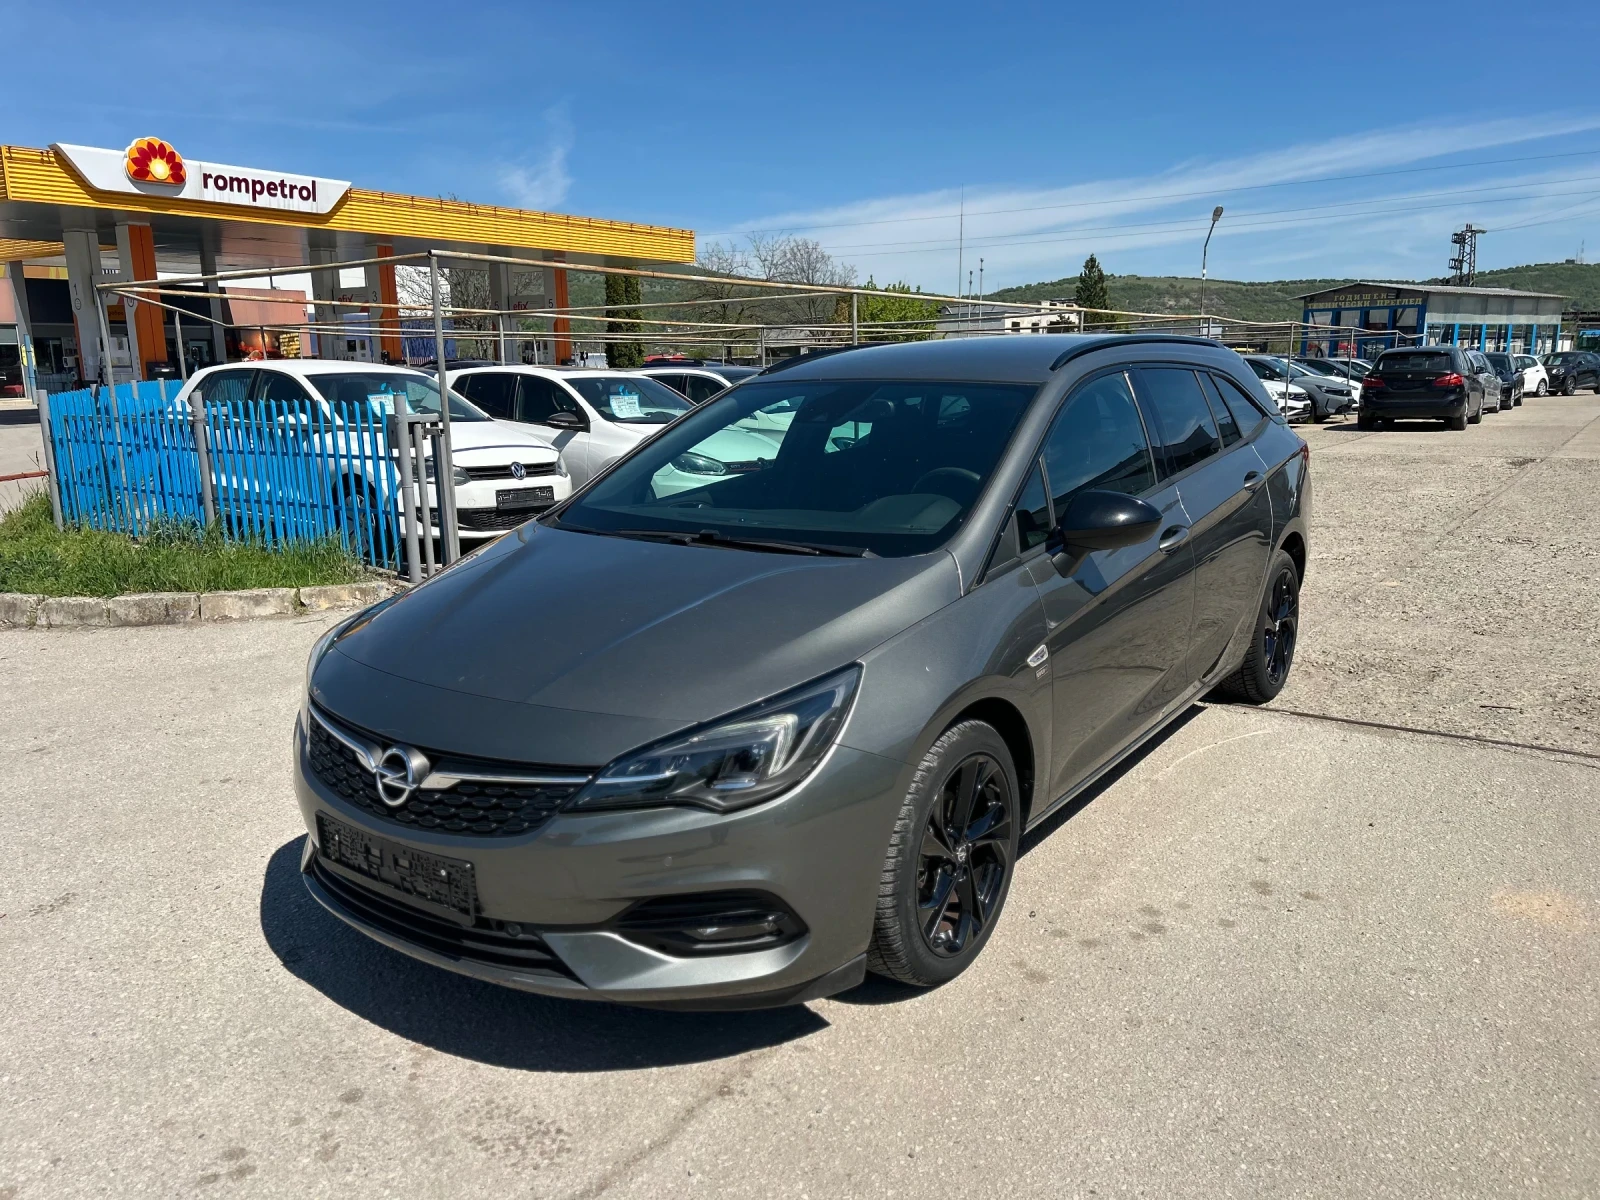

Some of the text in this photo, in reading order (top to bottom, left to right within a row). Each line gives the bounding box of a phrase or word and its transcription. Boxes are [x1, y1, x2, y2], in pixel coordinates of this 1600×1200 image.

[202, 172, 317, 203] rompetrol
[372, 290, 378, 303] 3
[1334, 293, 1387, 302] ГОДИШЕН
[513, 301, 529, 310] efix
[548, 298, 554, 309] 5
[1307, 297, 1423, 309] ТЕХНИЧЕСКИ ПРЕГЛЕД
